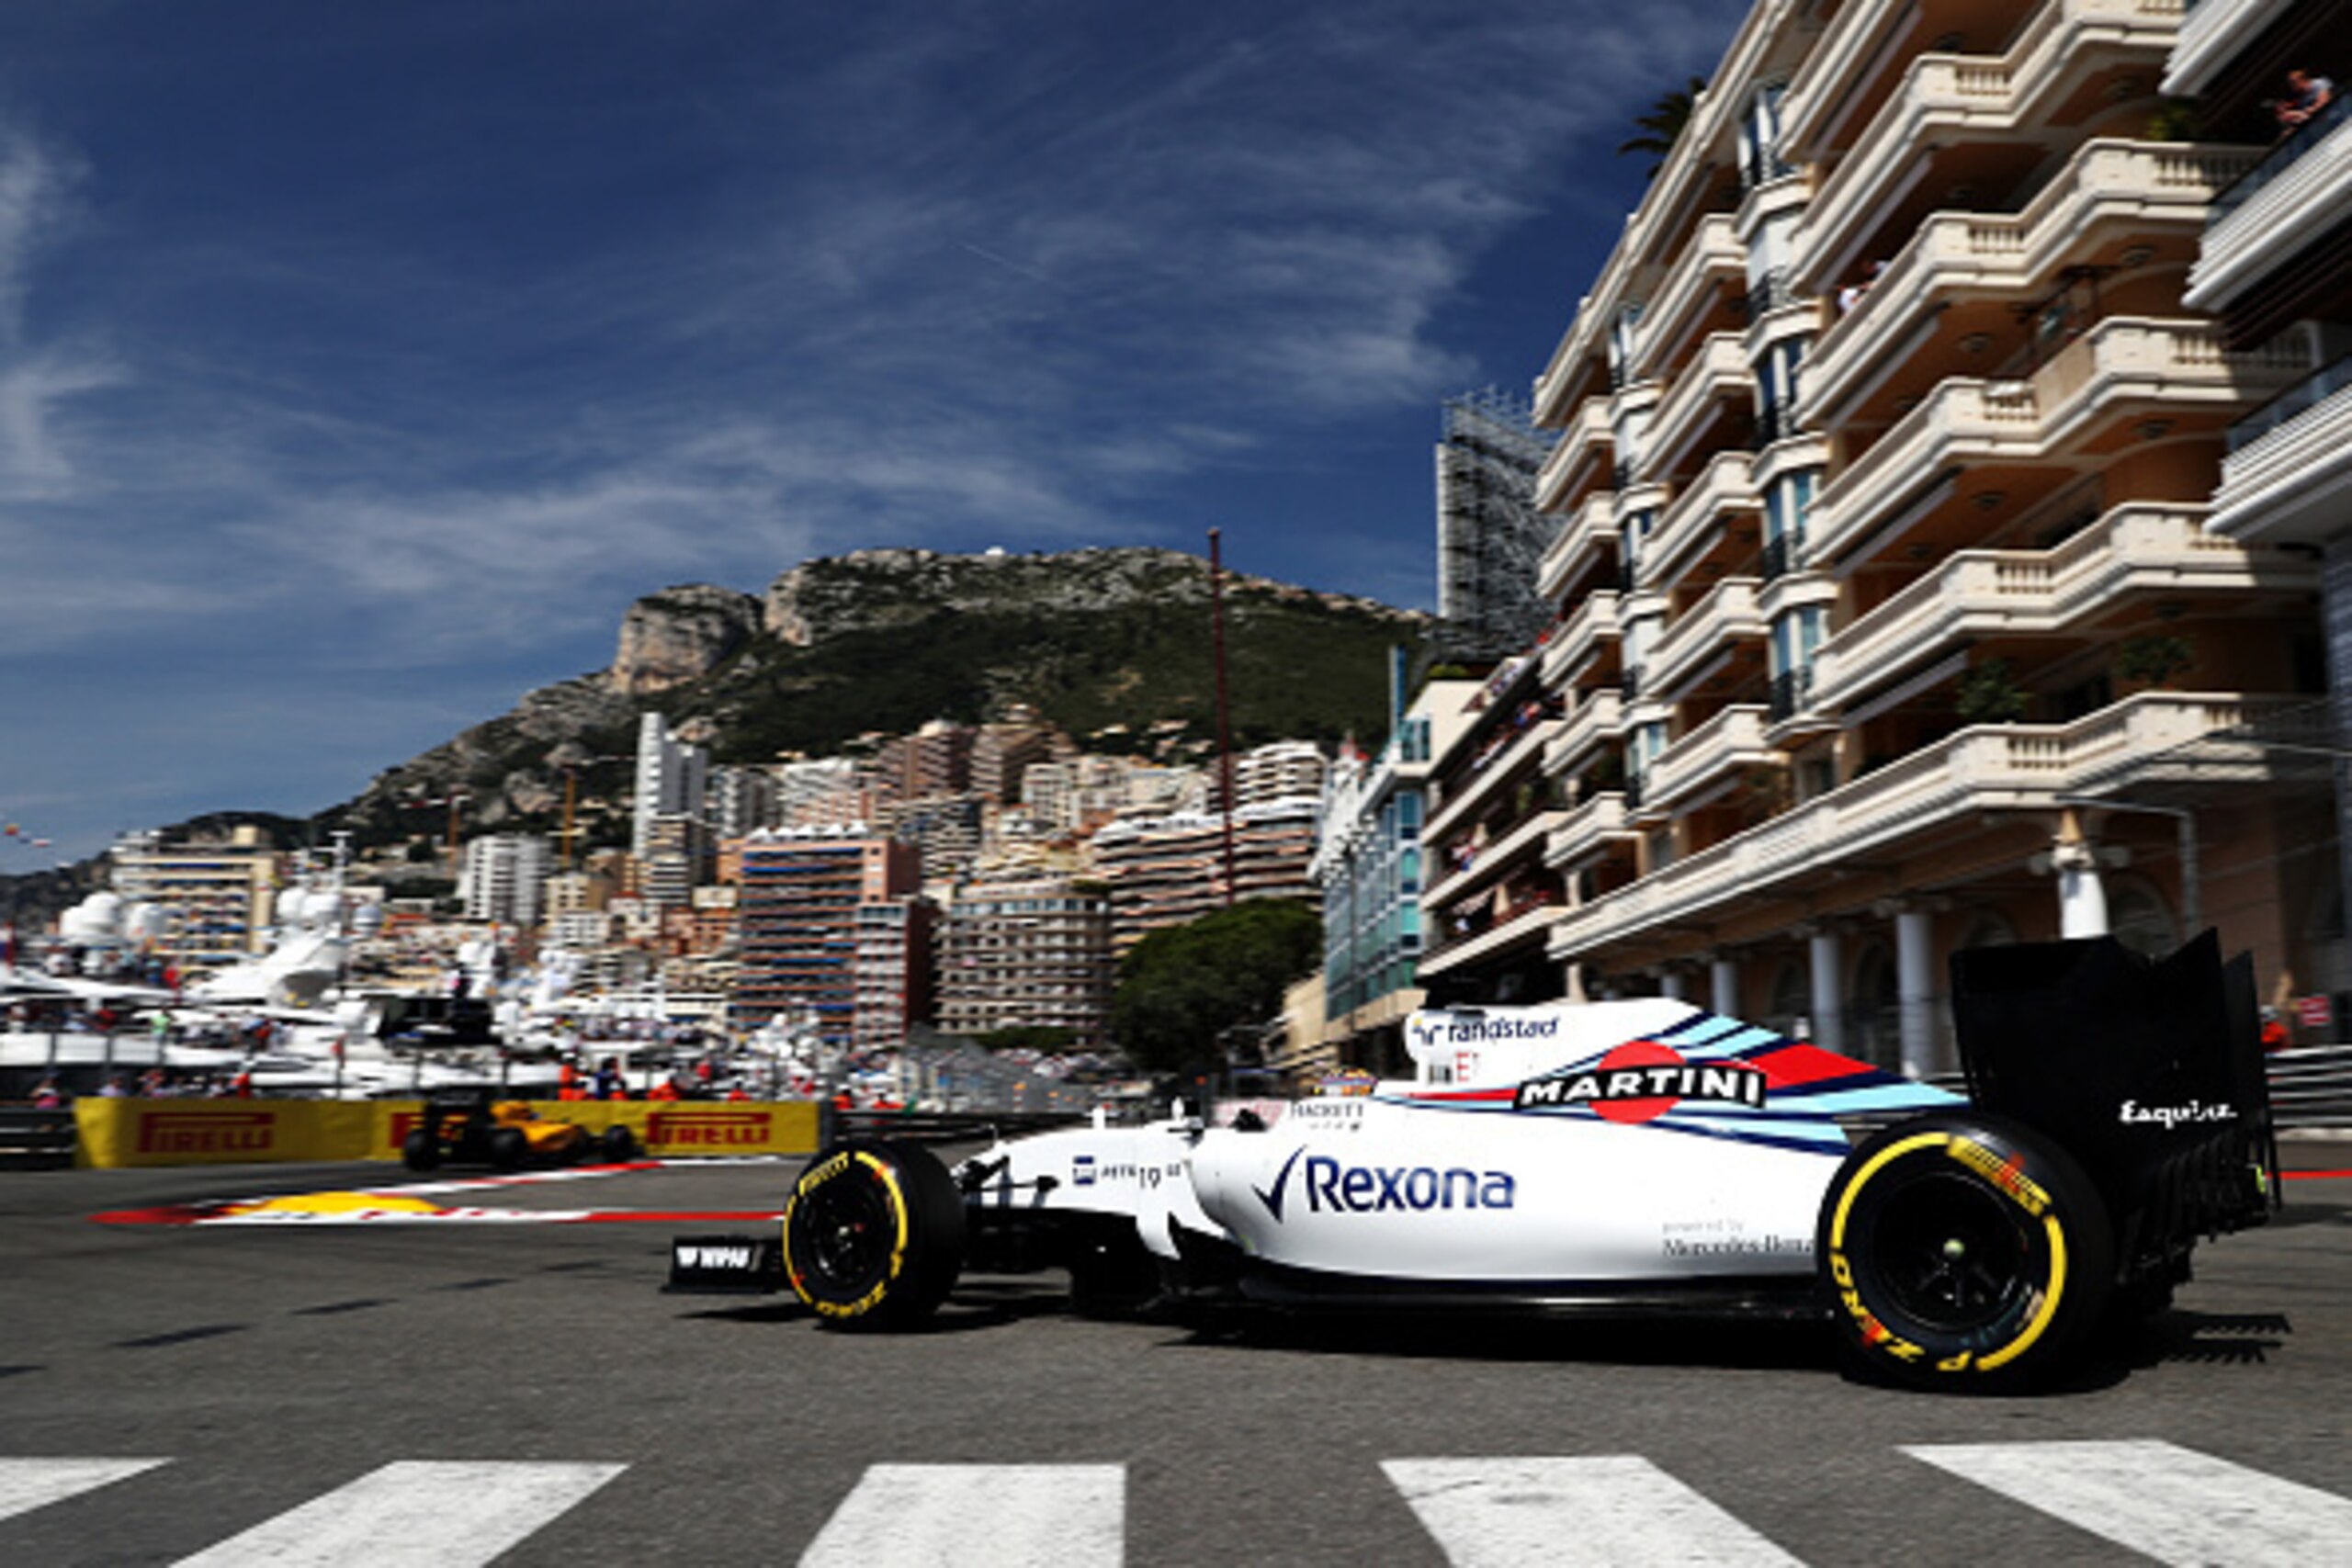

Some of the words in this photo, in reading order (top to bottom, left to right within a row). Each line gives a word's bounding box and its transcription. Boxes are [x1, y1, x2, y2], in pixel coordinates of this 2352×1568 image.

[1448, 1016, 1557, 1043] randstad
[1521, 1068, 1759, 1106] MARTINI
[138, 1111, 277, 1153] PIRELLI
[646, 1112, 772, 1145] PIRELLI
[2119, 1100, 2238, 1130] Esquire
[1306, 1156, 1516, 1213] Rexona
